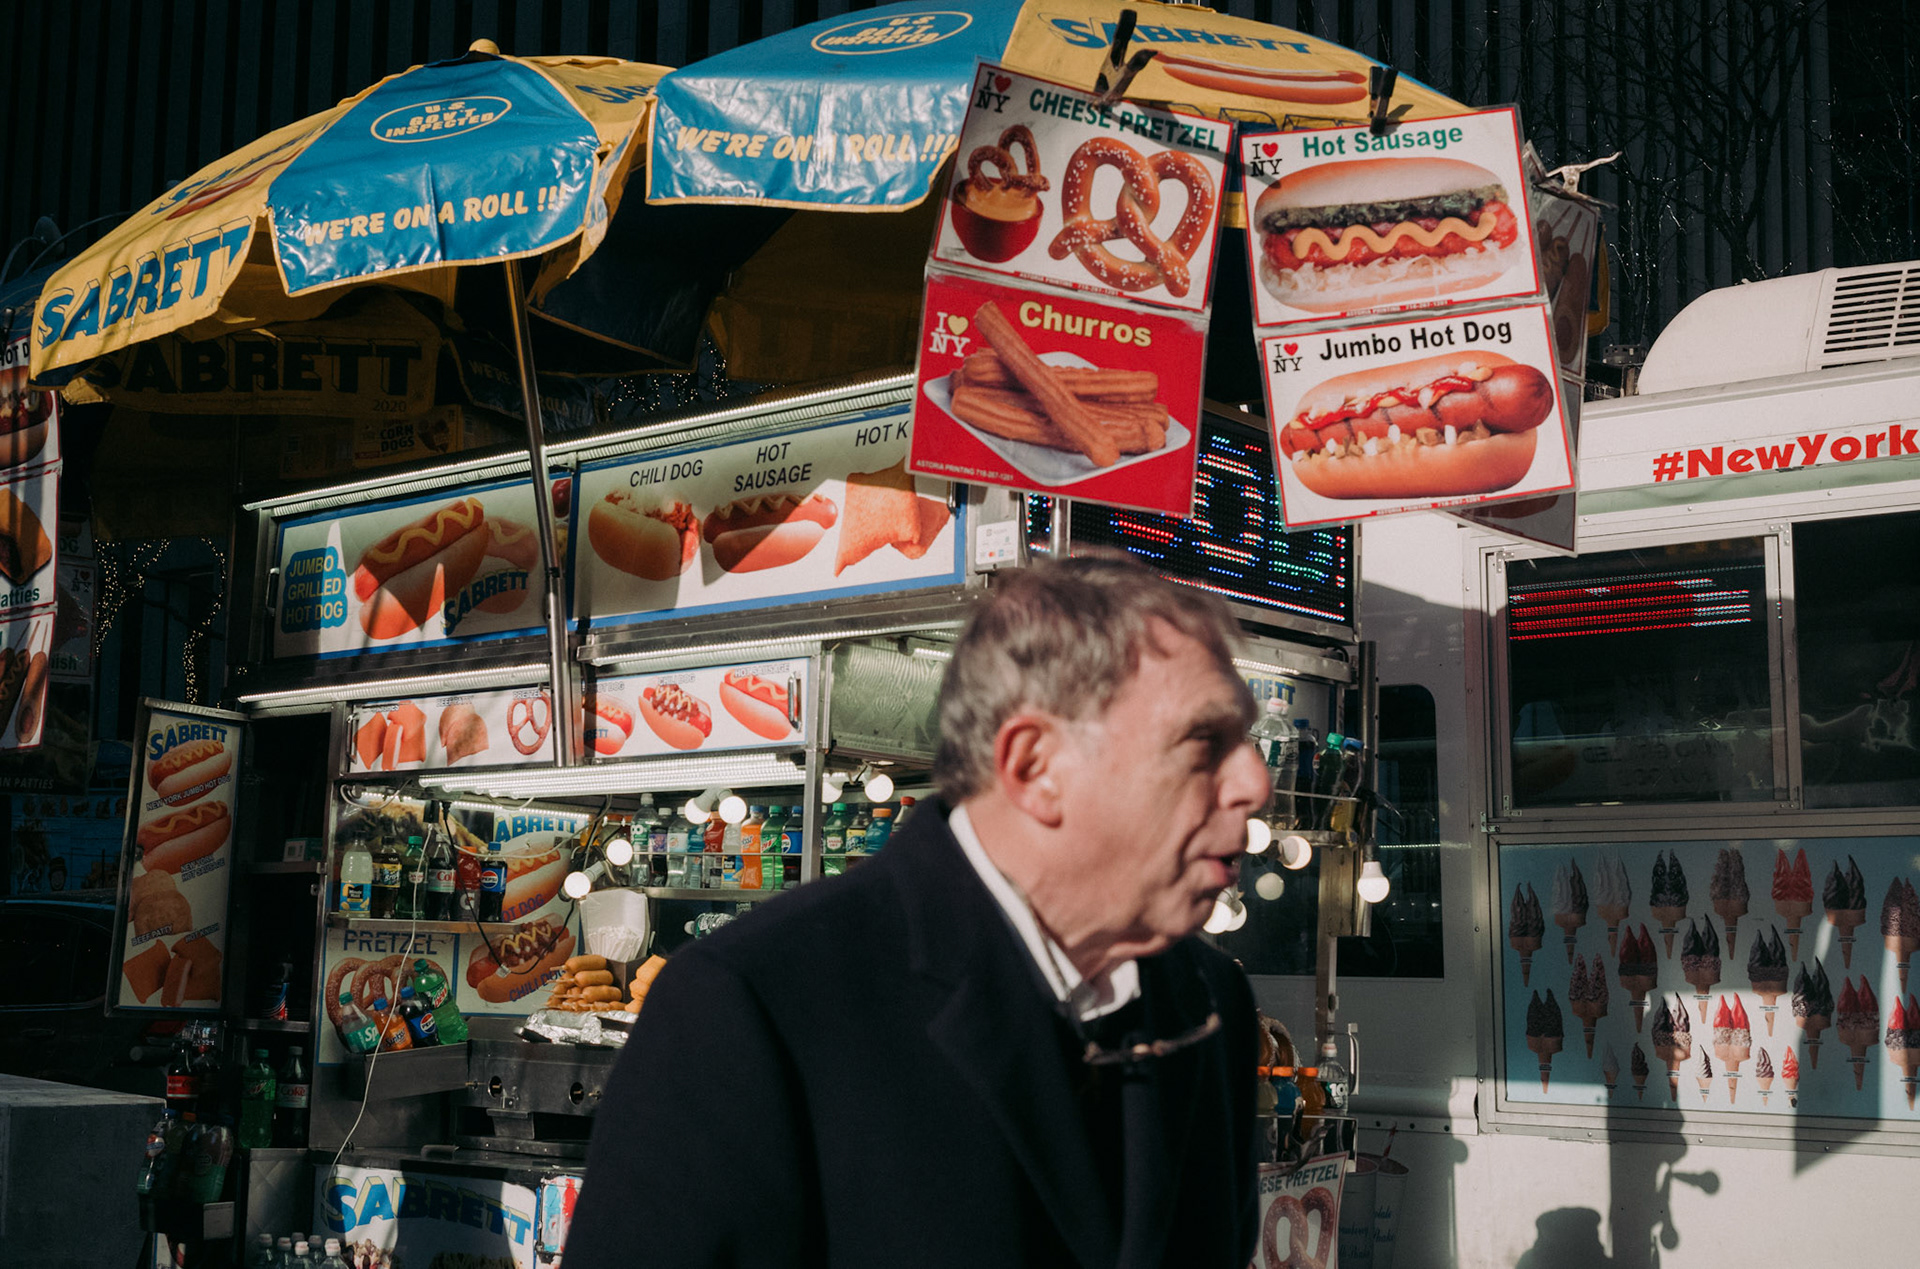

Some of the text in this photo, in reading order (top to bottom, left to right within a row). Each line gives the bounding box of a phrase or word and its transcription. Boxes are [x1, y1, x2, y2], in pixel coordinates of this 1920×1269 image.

[820, 33, 940, 46] INSPECTED
[974, 89, 1011, 113] NY
[385, 112, 494, 138] INSPECTED
[1029, 88, 1113, 129] CHEESE
[1119, 110, 1221, 151] PRETZEL
[676, 126, 769, 159] WE'RE
[772, 133, 814, 162] ON
[845, 134, 912, 162] ROLL
[1302, 126, 1463, 158] Hot Sausage
[1250, 158, 1283, 178] NY
[303, 212, 386, 247] WE'RE
[393, 204, 431, 230] ON
[438, 203, 456, 225] A
[464, 191, 528, 222] ROLL
[38, 216, 251, 350] SABRETT
[1019, 301, 1153, 348] Churros
[929, 331, 971, 357] NY
[1320, 320, 1513, 362] Jumbo Hot Dog
[1273, 356, 1303, 374] NY
[373, 399, 407, 413] 2020
[379, 424, 415, 440] CORN
[381, 435, 415, 452] DOGS
[855, 425, 893, 448] HOT
[755, 442, 791, 465] HOT
[1652, 424, 1920, 483] #NewYork
[629, 459, 704, 488] CHILI DOG
[733, 463, 812, 493] SAUSAGE
[945, 463, 975, 475] PRINTING
[289, 553, 335, 579] JUMBO
[0, 587, 40, 608] atties
[288, 576, 341, 601] GRILLED
[285, 600, 344, 626] HOT DOG
[440, 569, 529, 637] SABRETT
[1248, 676, 1296, 705] RETT
[147, 720, 228, 761] SABRETT
[14, 777, 54, 790] PATTIES
[146, 799, 163, 812] NEW
[163, 793, 182, 806] YORK
[183, 785, 204, 799] JUMBO
[205, 779, 217, 789] HOT
[495, 813, 577, 843] ABRETT
[501, 893, 544, 923] OT DOG
[343, 930, 437, 955] PRETZEL
[509, 979, 539, 1003] CHILI
[1286, 1163, 1339, 1189] PRETZEL
[322, 1176, 531, 1245] SABRETT
